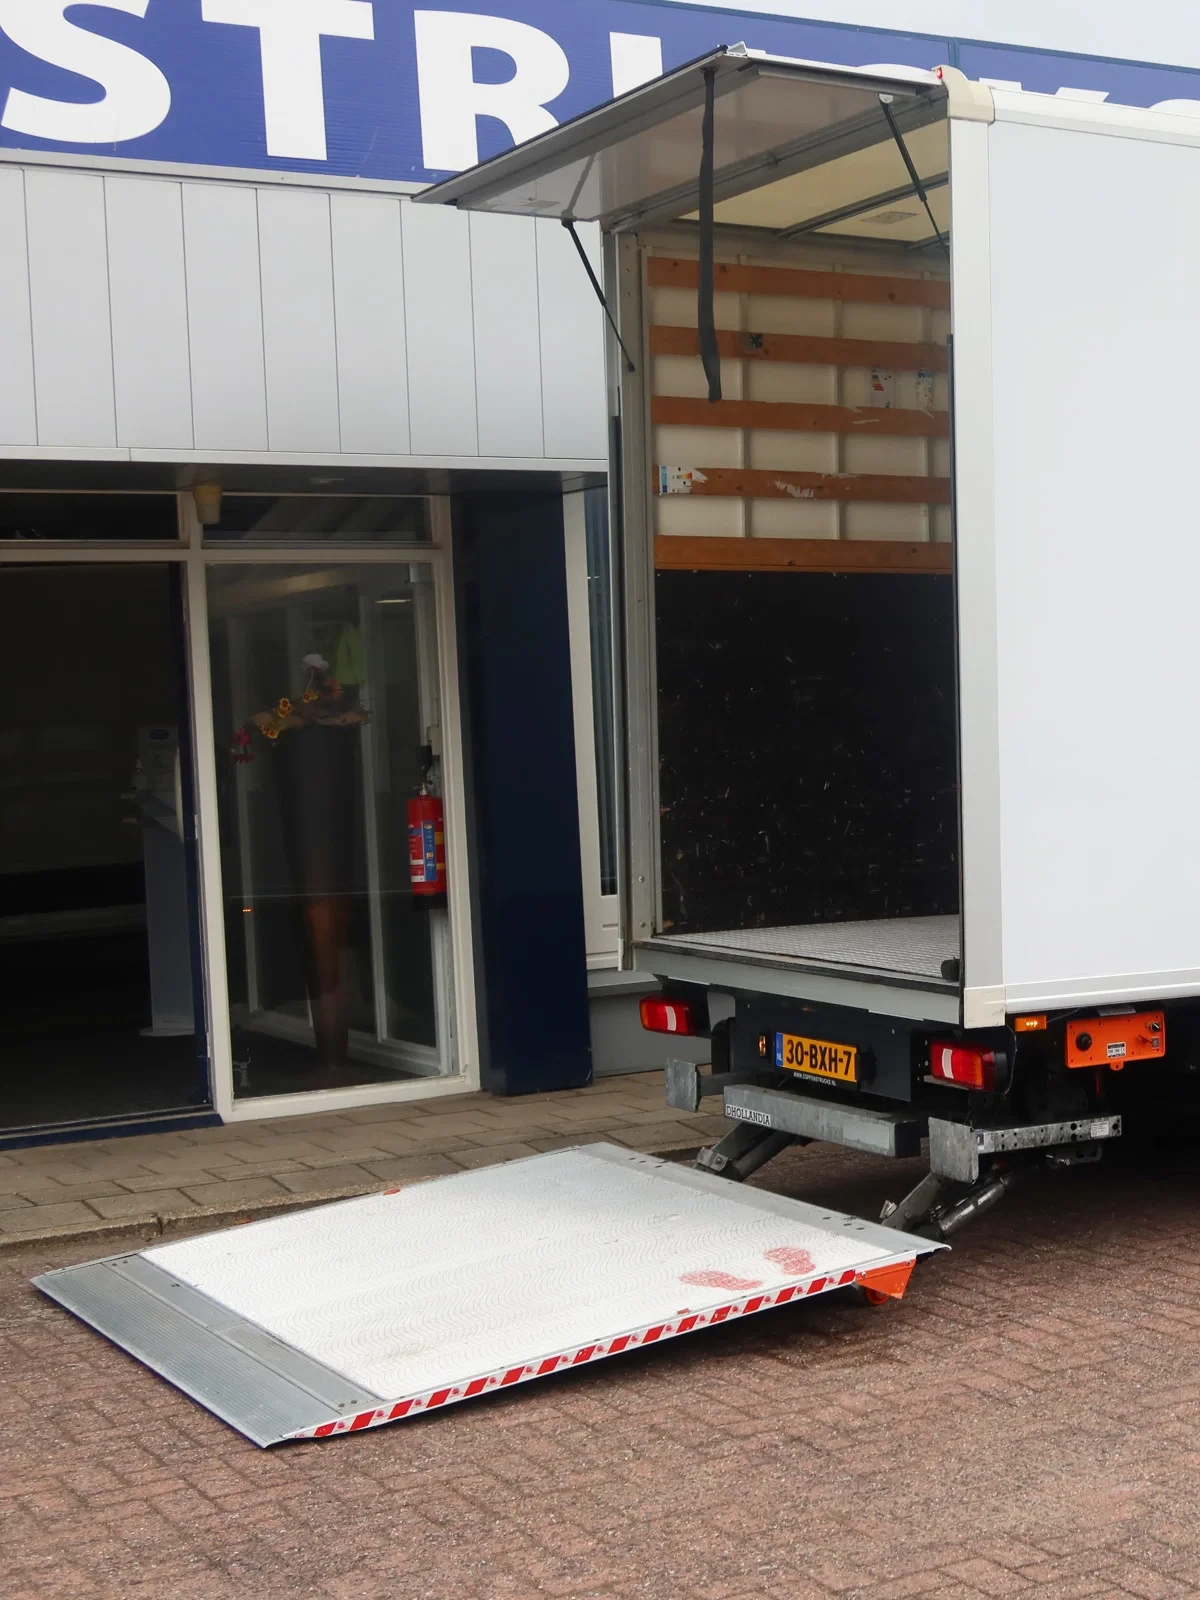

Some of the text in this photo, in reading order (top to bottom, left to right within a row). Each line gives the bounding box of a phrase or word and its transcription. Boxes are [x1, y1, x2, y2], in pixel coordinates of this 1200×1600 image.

[776, 1052, 783, 1062] NL
[786, 1039, 852, 1076] 30-BXH-7
[726, 1105, 771, 1126] DHOLLANDIA
